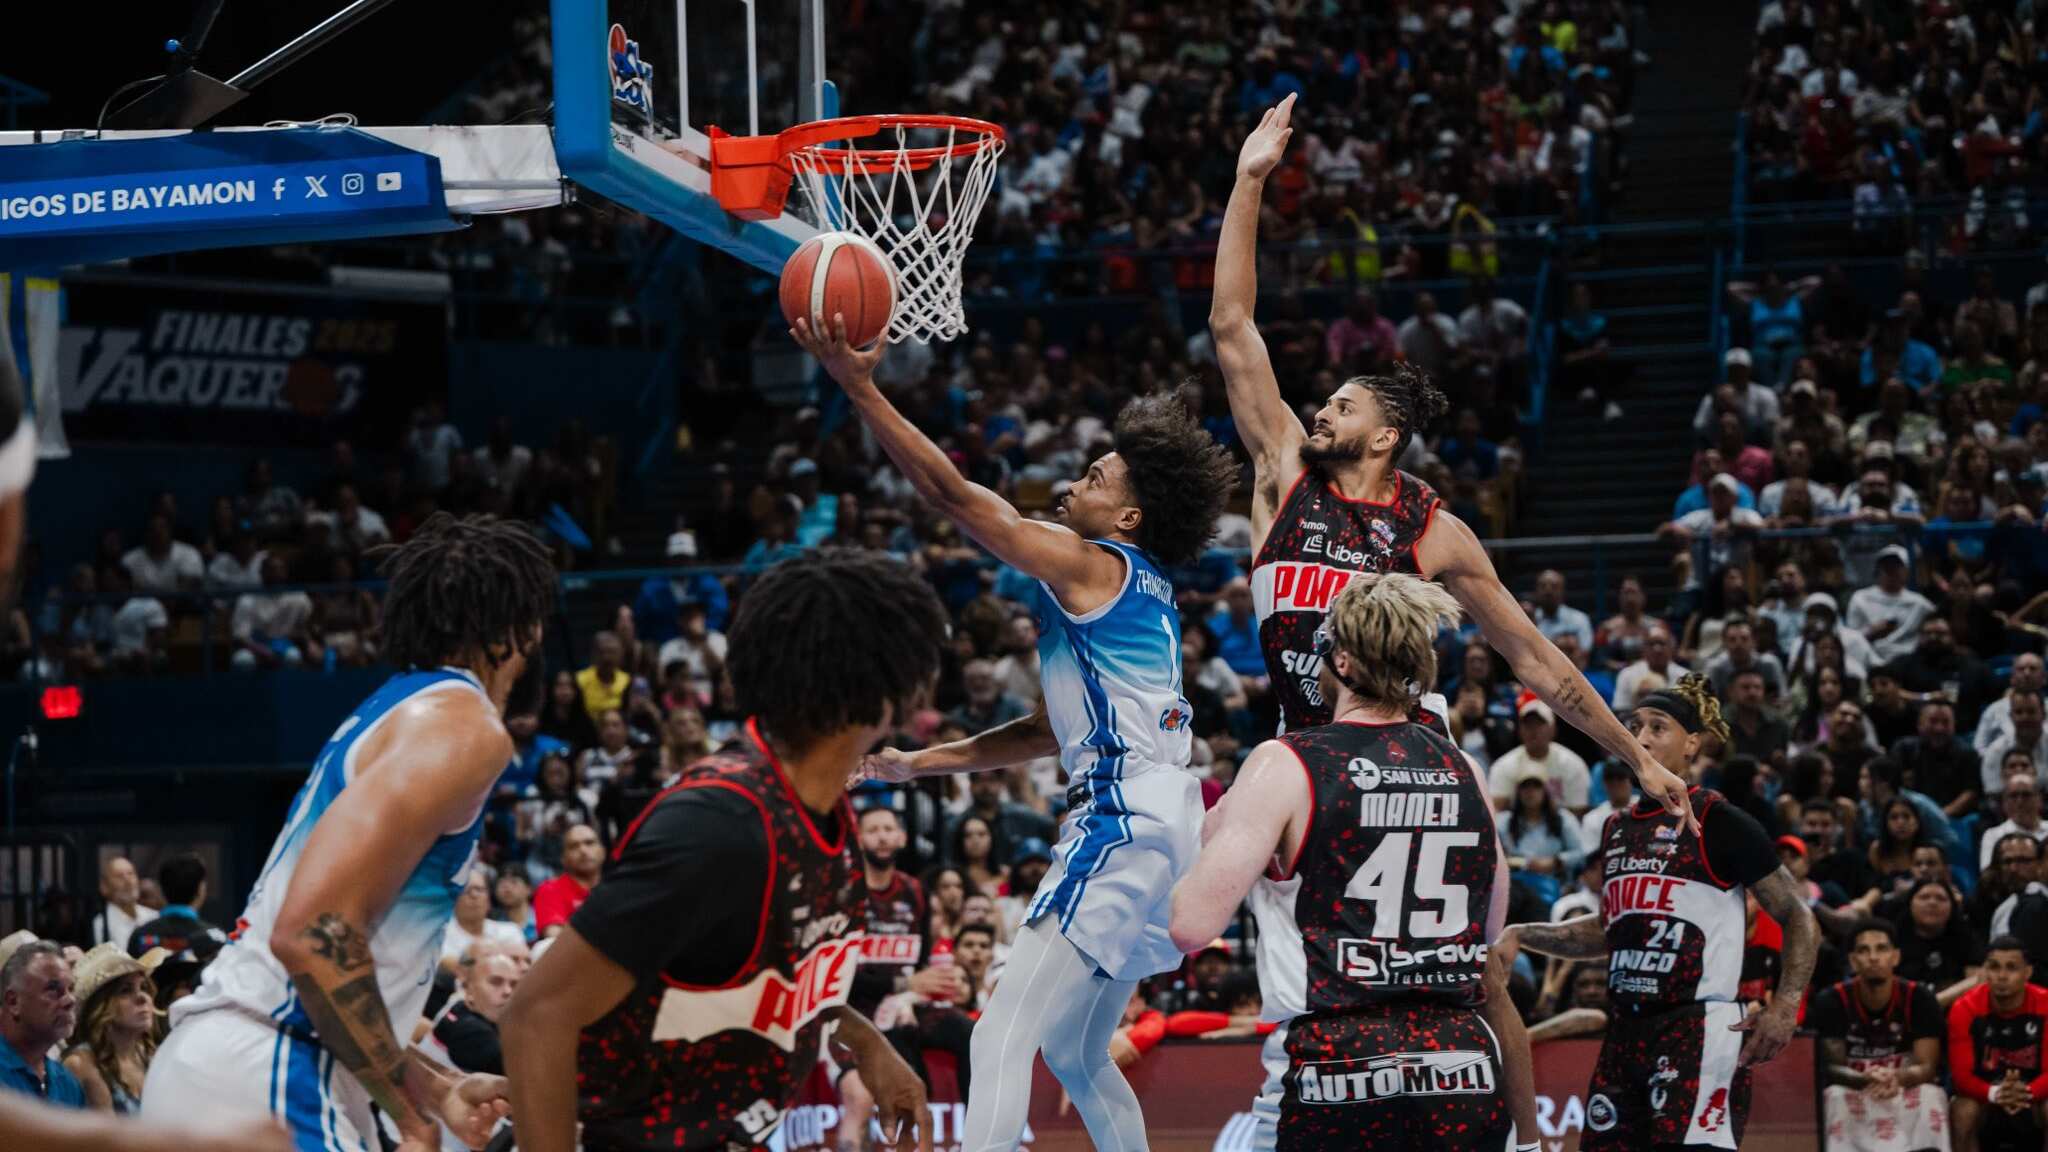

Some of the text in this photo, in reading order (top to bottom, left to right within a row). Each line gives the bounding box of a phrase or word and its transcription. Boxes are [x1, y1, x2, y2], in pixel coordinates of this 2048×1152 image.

[0, 180, 256, 220] IGOS DE BAYAMON
[151, 311, 398, 357] FINALES 2025
[1273, 565, 1351, 610] PON
[1161, 613, 1181, 691] 1
[1382, 770, 1459, 786] SAN LUCAS
[1360, 792, 1459, 827] MANEK
[1344, 832, 1480, 938] 45
[1621, 857, 1669, 874] Liberty
[1646, 920, 1686, 950] 24
